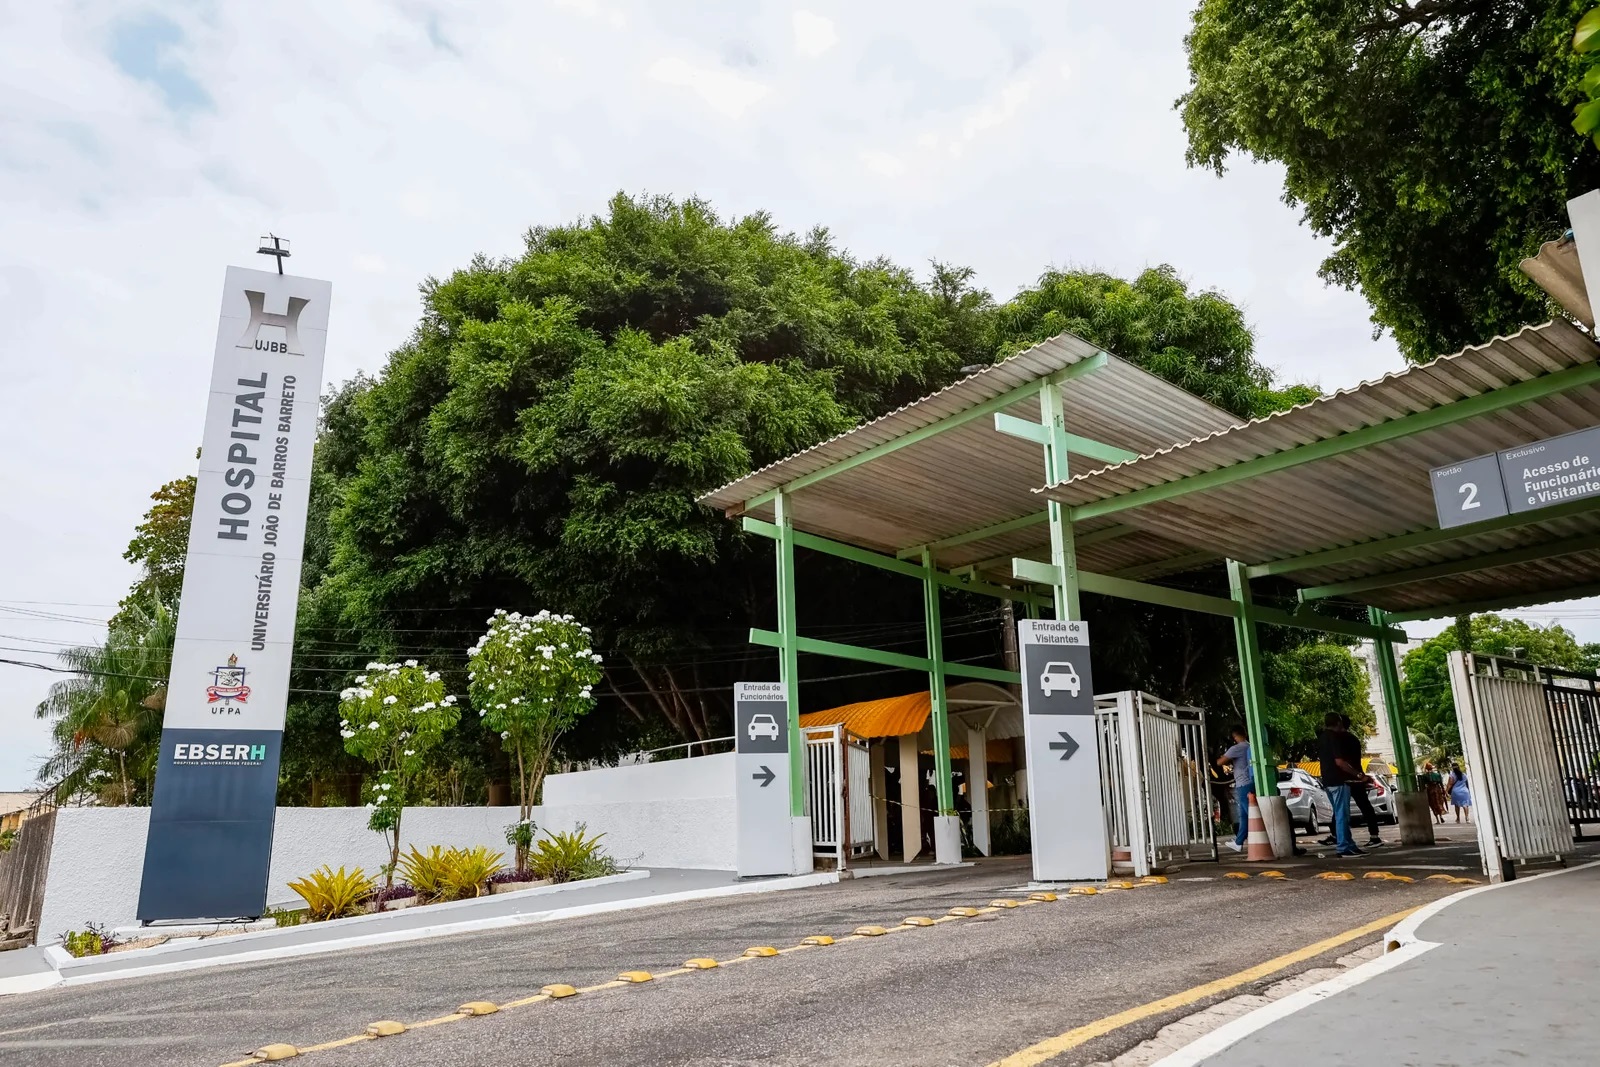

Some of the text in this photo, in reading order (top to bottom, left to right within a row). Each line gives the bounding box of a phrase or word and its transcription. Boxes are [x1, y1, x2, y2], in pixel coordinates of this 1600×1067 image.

[254, 339, 288, 354] UJBB
[217, 371, 268, 541] HOSPITAL
[1506, 444, 1546, 461] Exclusivo
[1437, 466, 1462, 478] Portão
[1523, 455, 1590, 480] Acesso de
[1458, 482, 1481, 511] 2
[1527, 495, 1536, 505] e
[251, 375, 297, 652] UNIVERSITÁRIO JOÃO DE BARROS BARRETO
[1032, 621, 1080, 632] Entrada de
[1035, 634, 1079, 644] Visitantes
[743, 683, 770, 691] Entrada
[740, 692, 784, 701] Funcionários
[211, 707, 241, 715] UFPA
[173, 743, 266, 760] EBSERH
